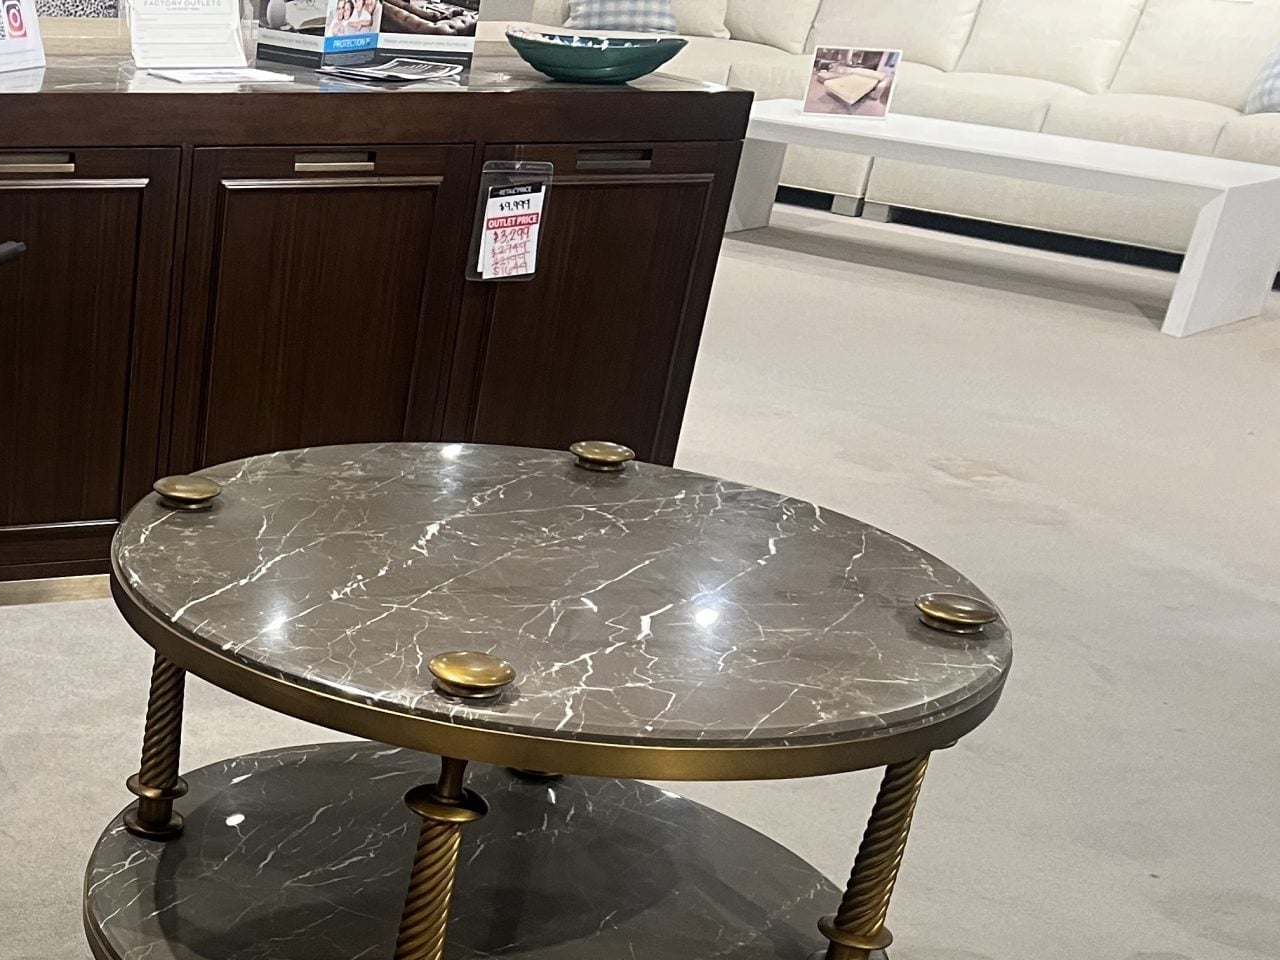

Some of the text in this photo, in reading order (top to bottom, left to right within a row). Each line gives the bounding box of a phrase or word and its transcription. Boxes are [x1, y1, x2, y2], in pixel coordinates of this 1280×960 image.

[333, 38, 365, 48] PROTECTION
[488, 215, 537, 228] OUTLET PRICE
